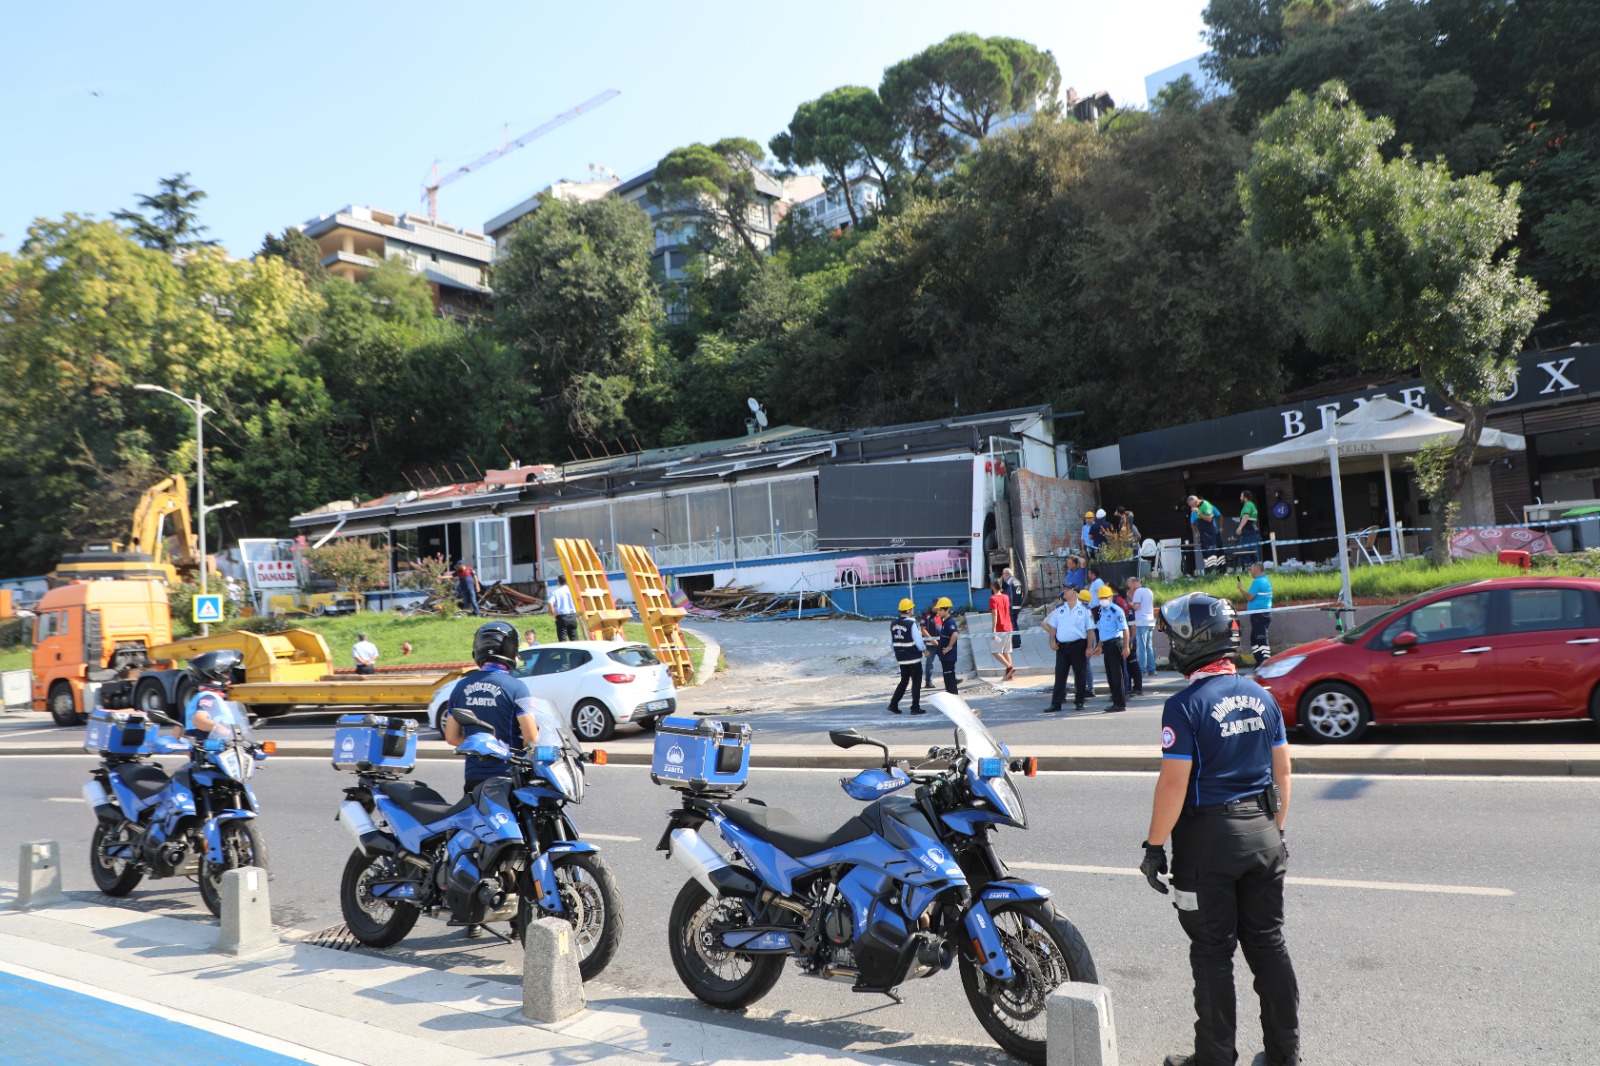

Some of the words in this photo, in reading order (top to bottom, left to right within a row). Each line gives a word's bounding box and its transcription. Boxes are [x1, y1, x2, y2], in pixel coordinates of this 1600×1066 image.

[465, 696, 497, 707] ZABITA
[1210, 695, 1266, 723] BÜYÜKŞEHİR
[1219, 716, 1266, 738] ZABITA
[663, 765, 684, 775] ZABITA
